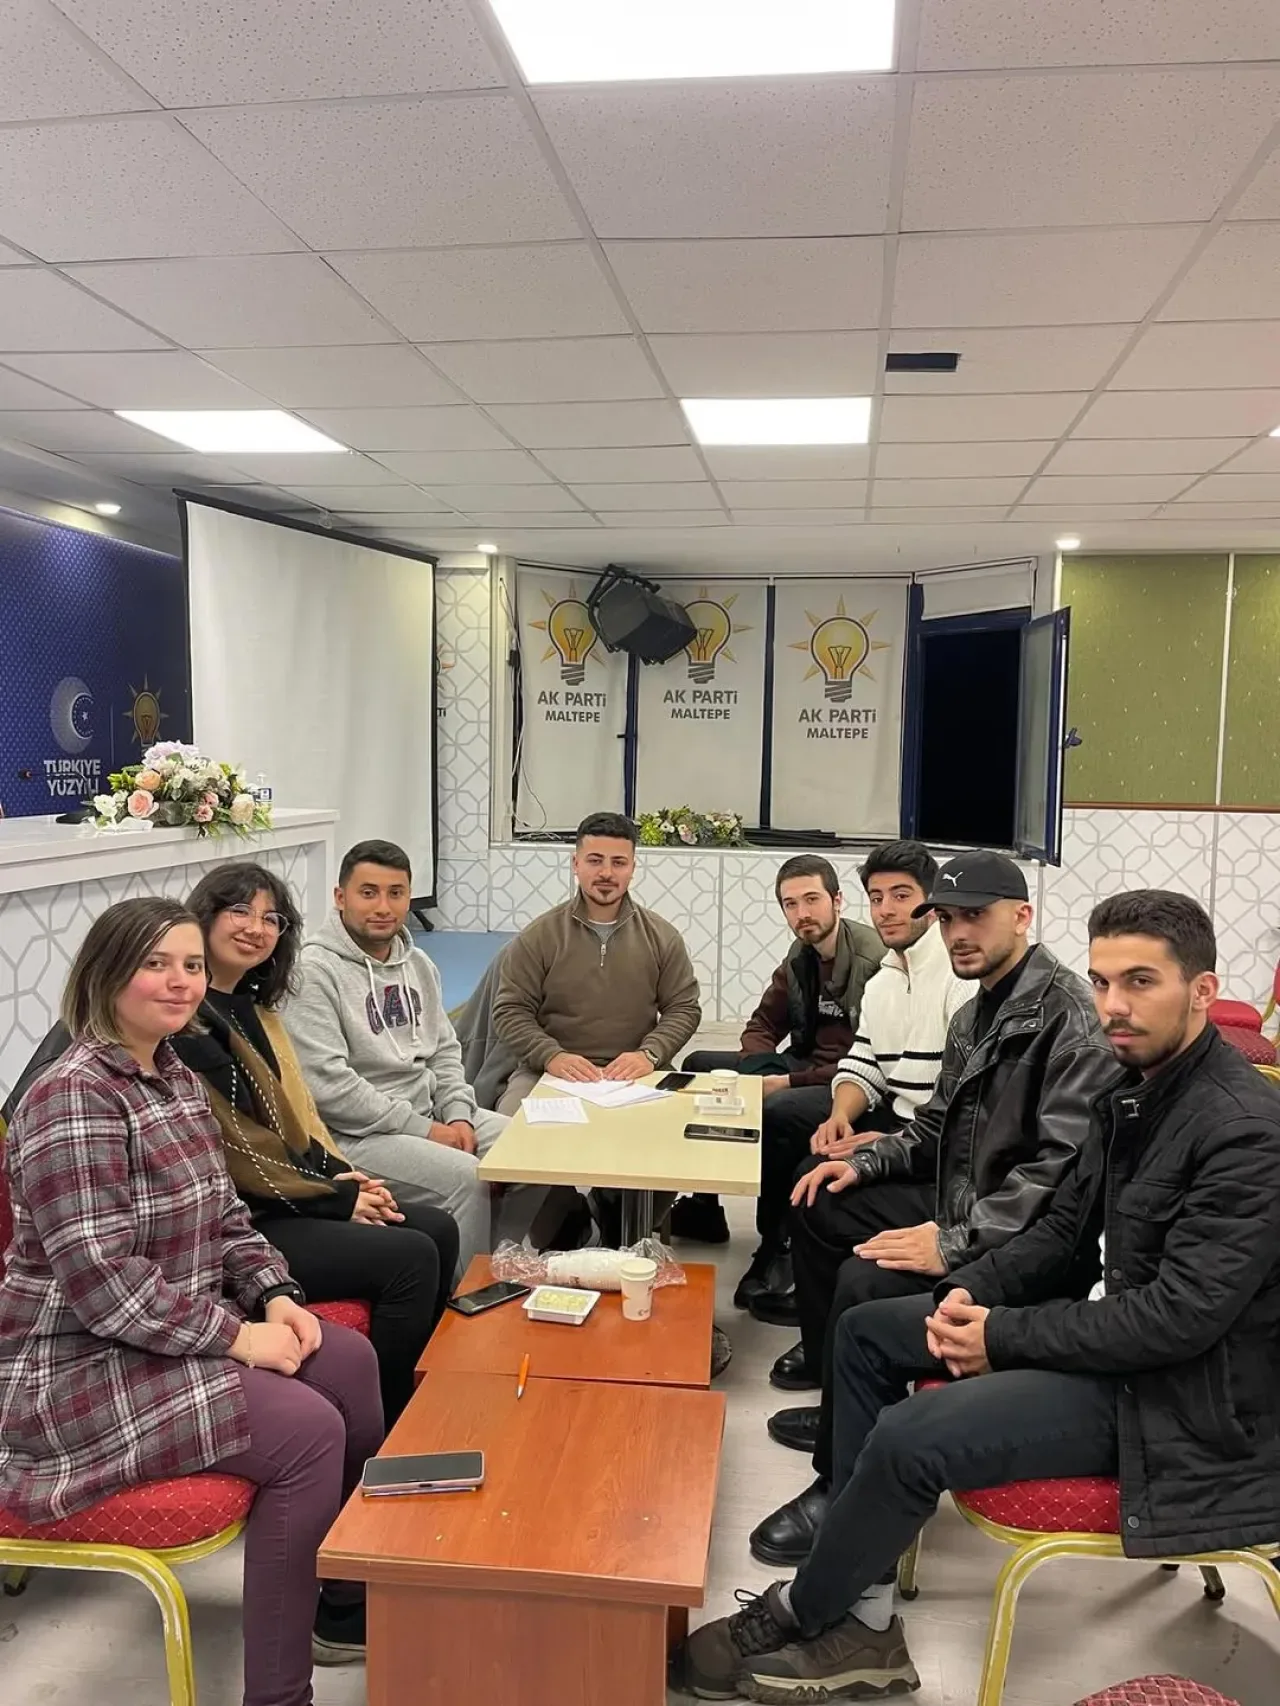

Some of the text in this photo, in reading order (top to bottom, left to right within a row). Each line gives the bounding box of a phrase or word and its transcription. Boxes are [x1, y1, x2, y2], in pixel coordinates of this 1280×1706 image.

[537, 690, 560, 705] AK
[663, 689, 686, 704] AK
[545, 710, 600, 723] MALTEPE
[671, 708, 730, 720] MALTEPE
[798, 708, 822, 723] AK
[806, 727, 869, 739] MALTEPE
[365, 984, 422, 1035] GAP
